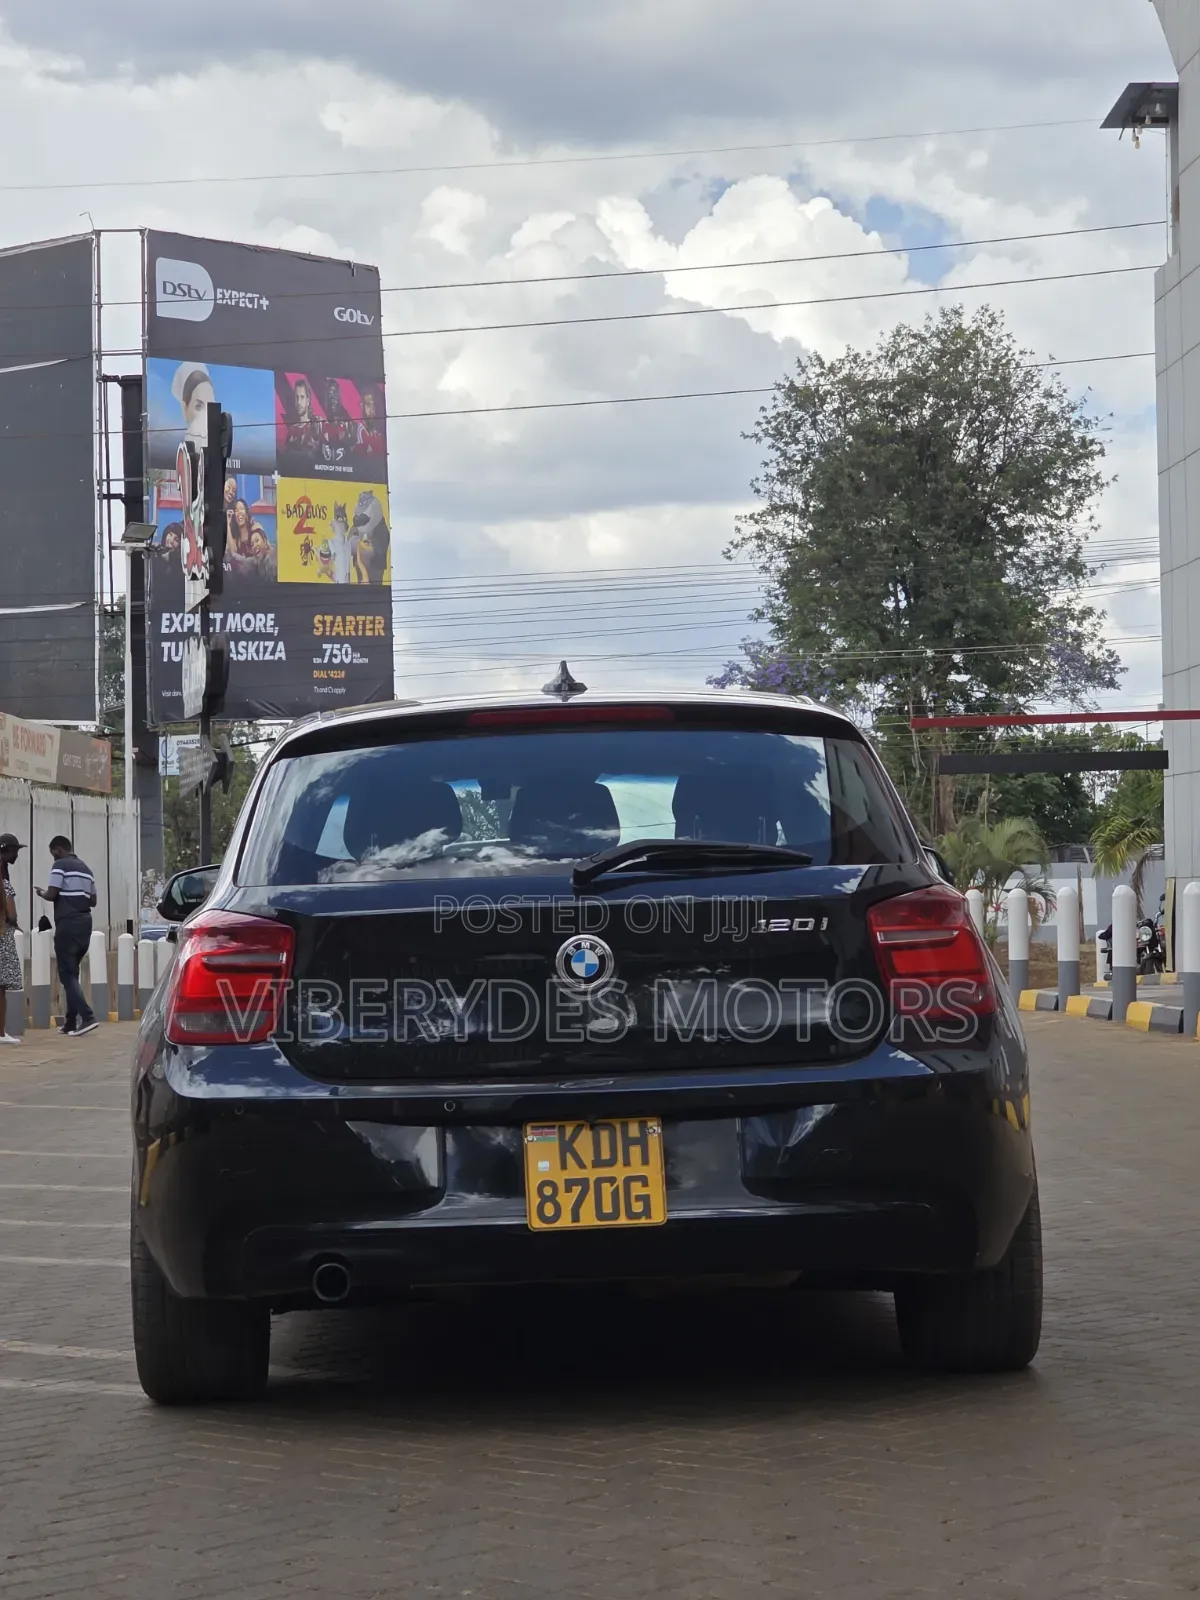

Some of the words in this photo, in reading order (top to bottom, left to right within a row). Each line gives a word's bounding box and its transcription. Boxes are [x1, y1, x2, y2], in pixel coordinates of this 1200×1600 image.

[162, 280, 207, 300] DStv
[286, 503, 304, 519] BAD
[161, 612, 224, 634] EXPET
[225, 612, 279, 637] MORE,
[313, 614, 386, 636] STARTER
[322, 643, 352, 664] 750
[313, 669, 328, 679] DIAL
[566, 941, 605, 957] BMW
[557, 1120, 650, 1171] KDH
[536, 1174, 653, 1225] 870G
